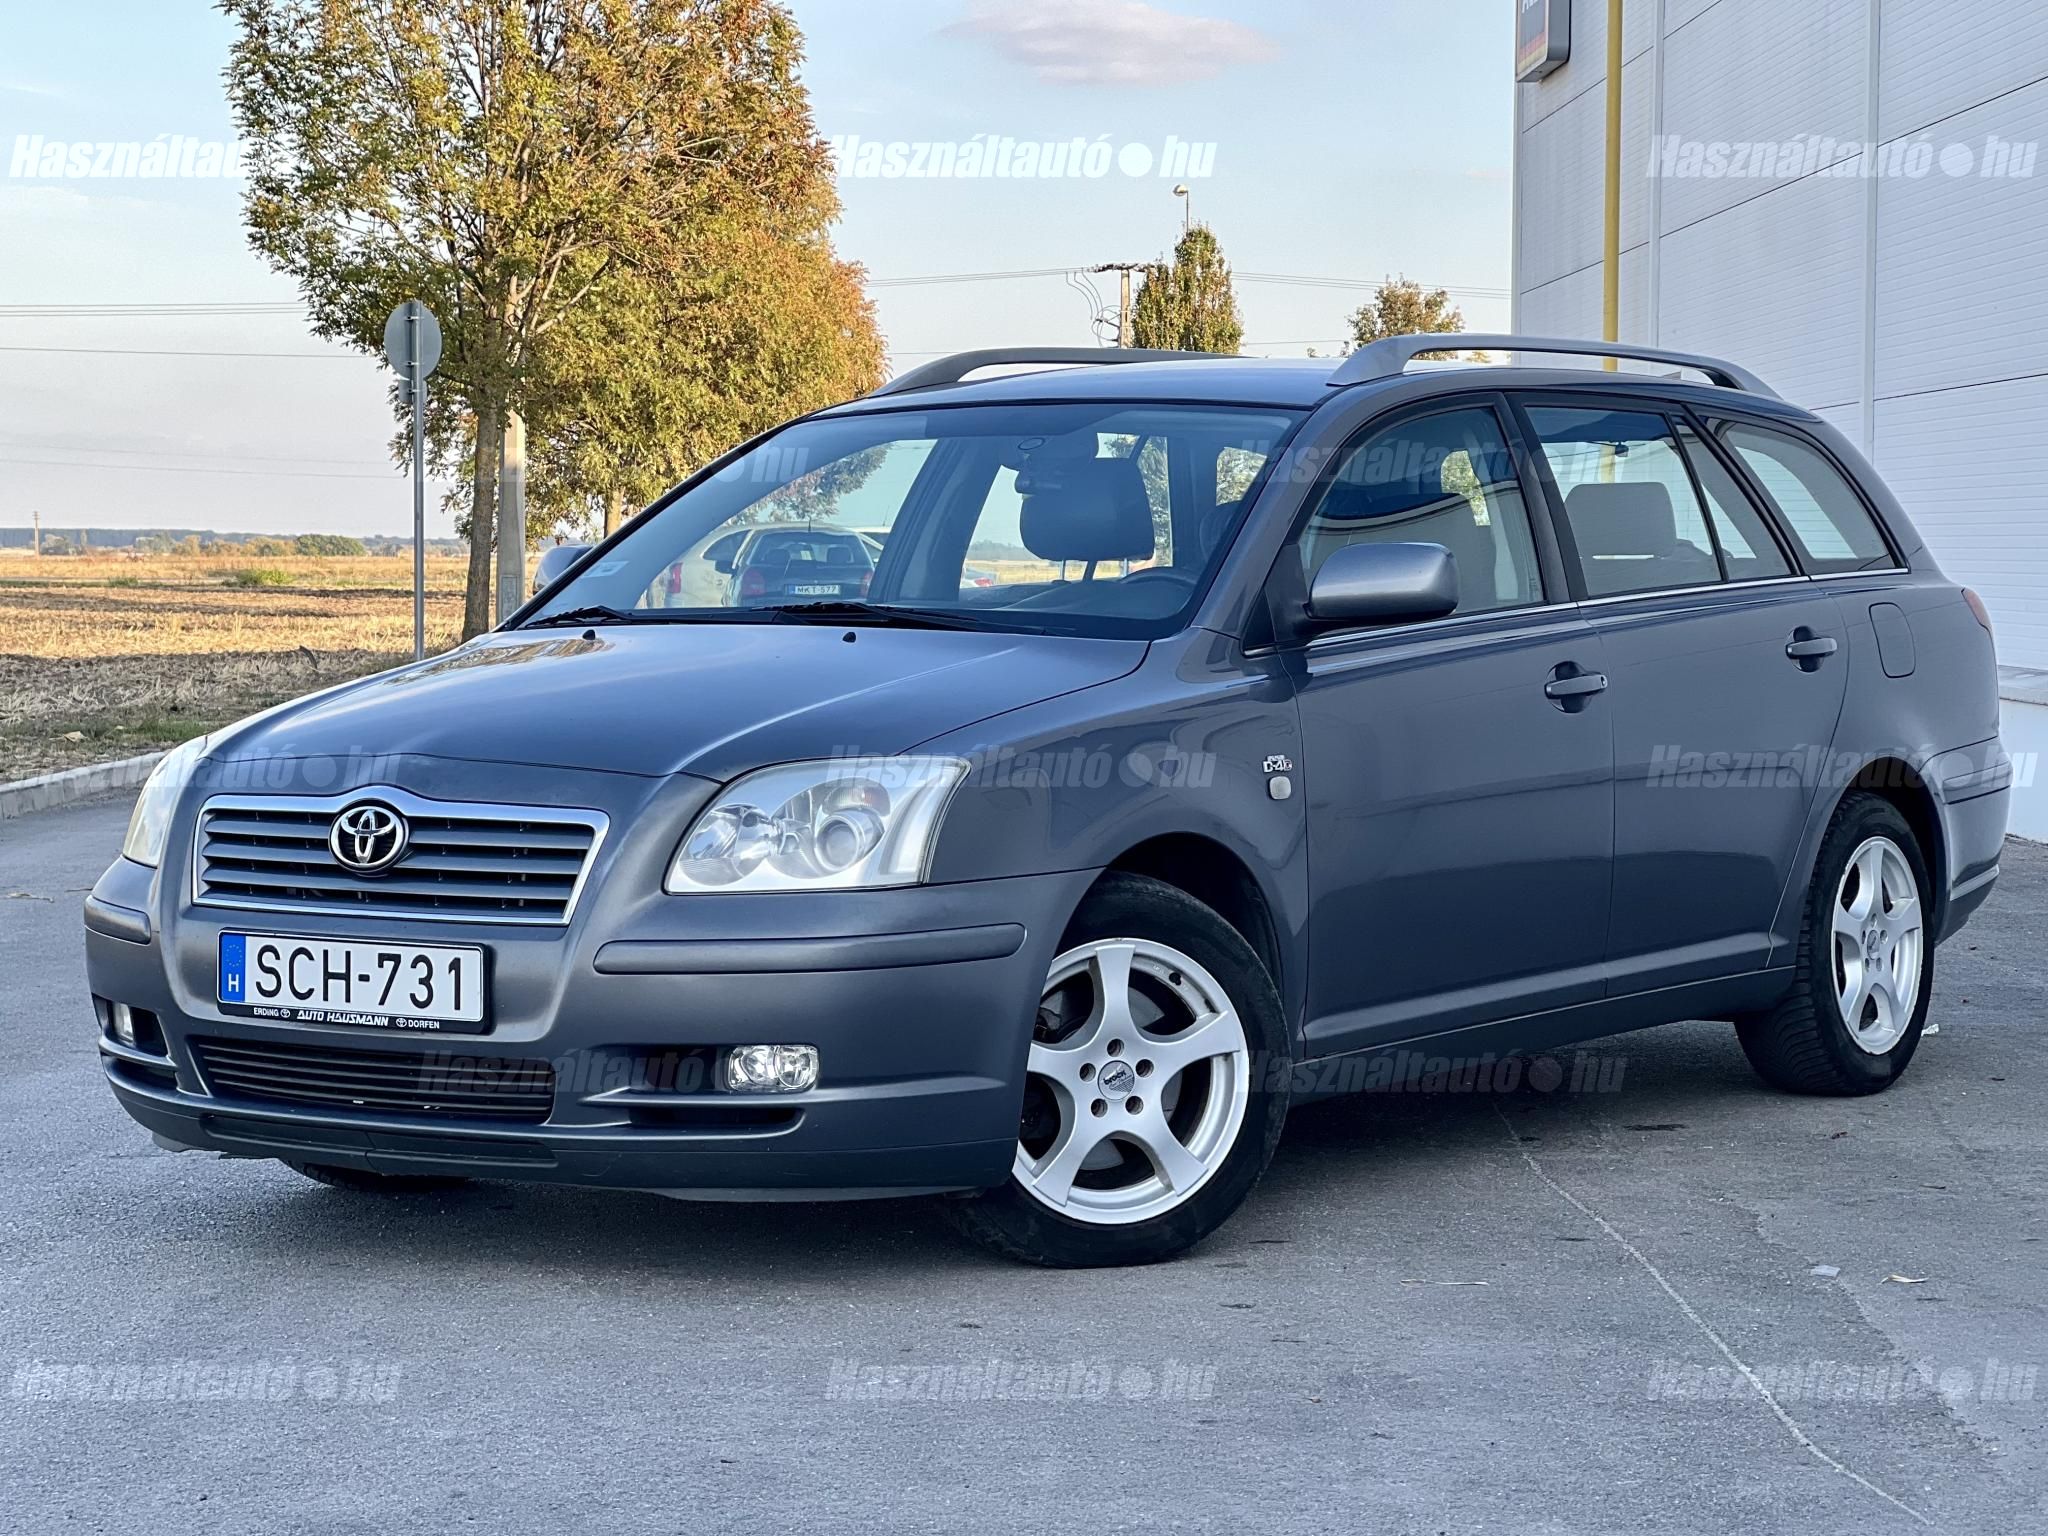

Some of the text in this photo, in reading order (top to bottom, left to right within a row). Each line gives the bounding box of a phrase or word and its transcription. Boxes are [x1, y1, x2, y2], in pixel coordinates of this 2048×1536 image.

[228, 973, 239, 993] H
[255, 944, 462, 1011] SCH-731
[253, 1007, 279, 1017] ERDING
[297, 1010, 389, 1027] AUTO HAUSMANN
[408, 1019, 440, 1029] DORFEN
